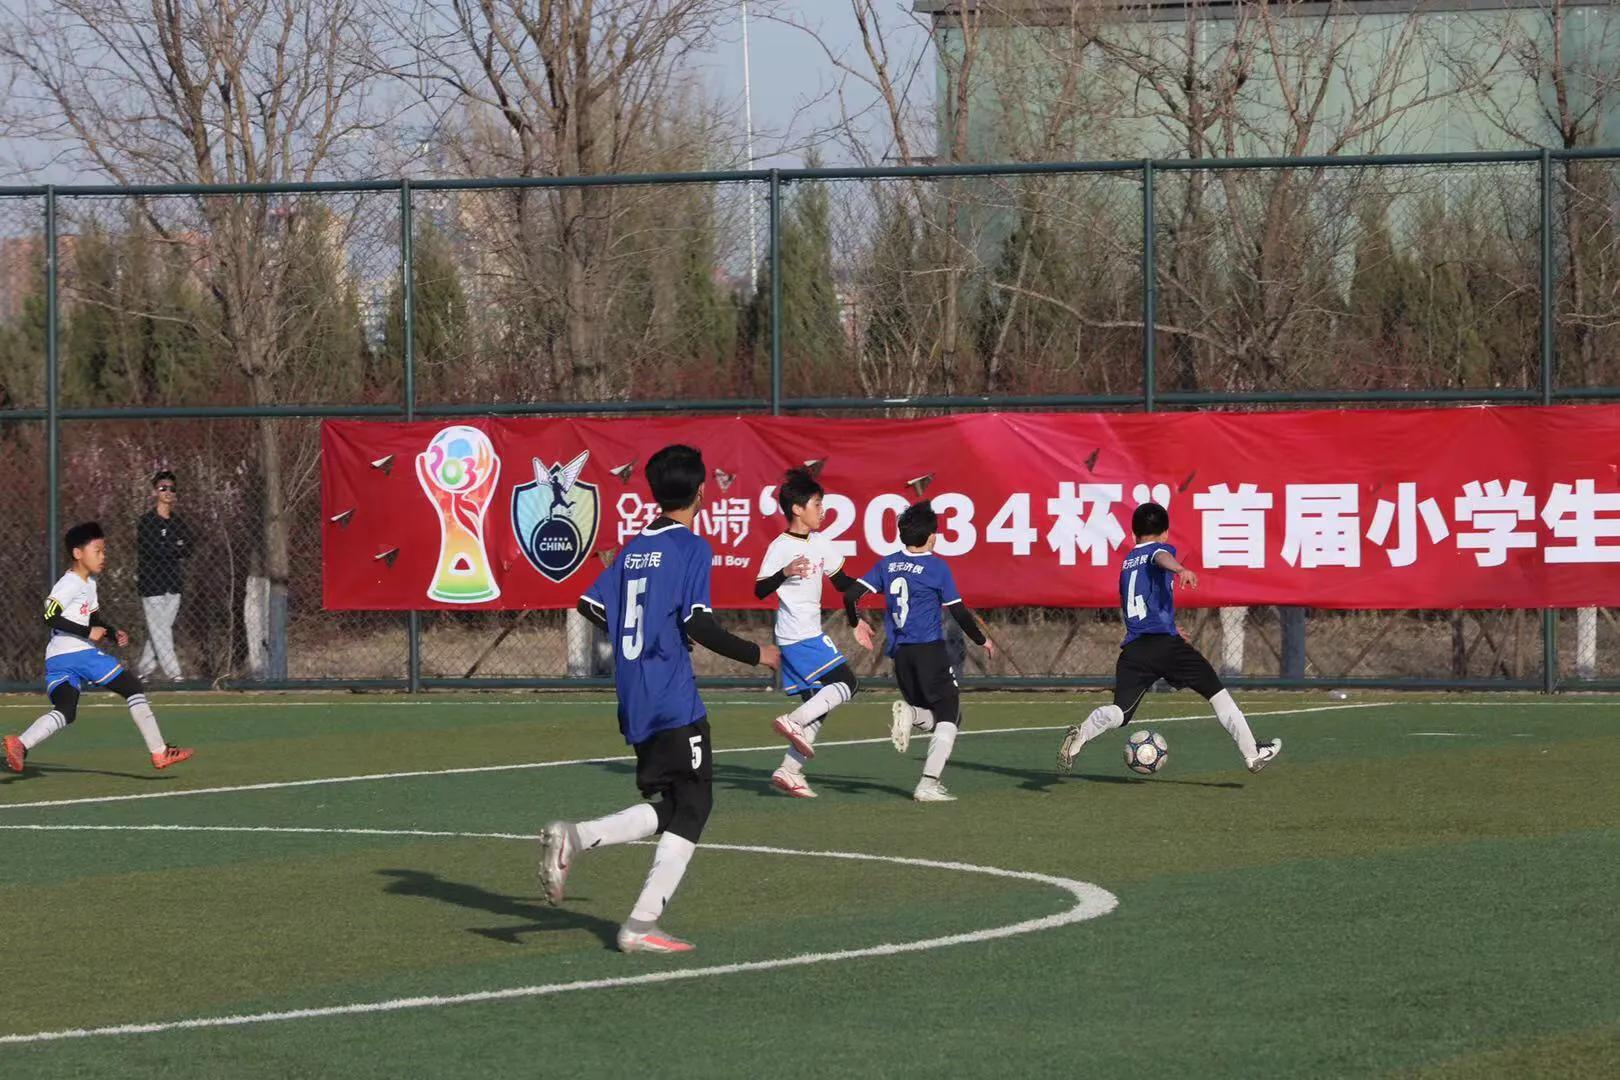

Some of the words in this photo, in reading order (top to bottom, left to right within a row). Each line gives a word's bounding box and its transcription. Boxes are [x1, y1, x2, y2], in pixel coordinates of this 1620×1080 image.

[539, 542, 573, 551] CHINA
[725, 555, 750, 568] Boy
[890, 577, 909, 629] 3
[1126, 569, 1147, 621] 4
[622, 577, 647, 661] 5
[822, 635, 838, 654] 9
[689, 735, 702, 770] 5
